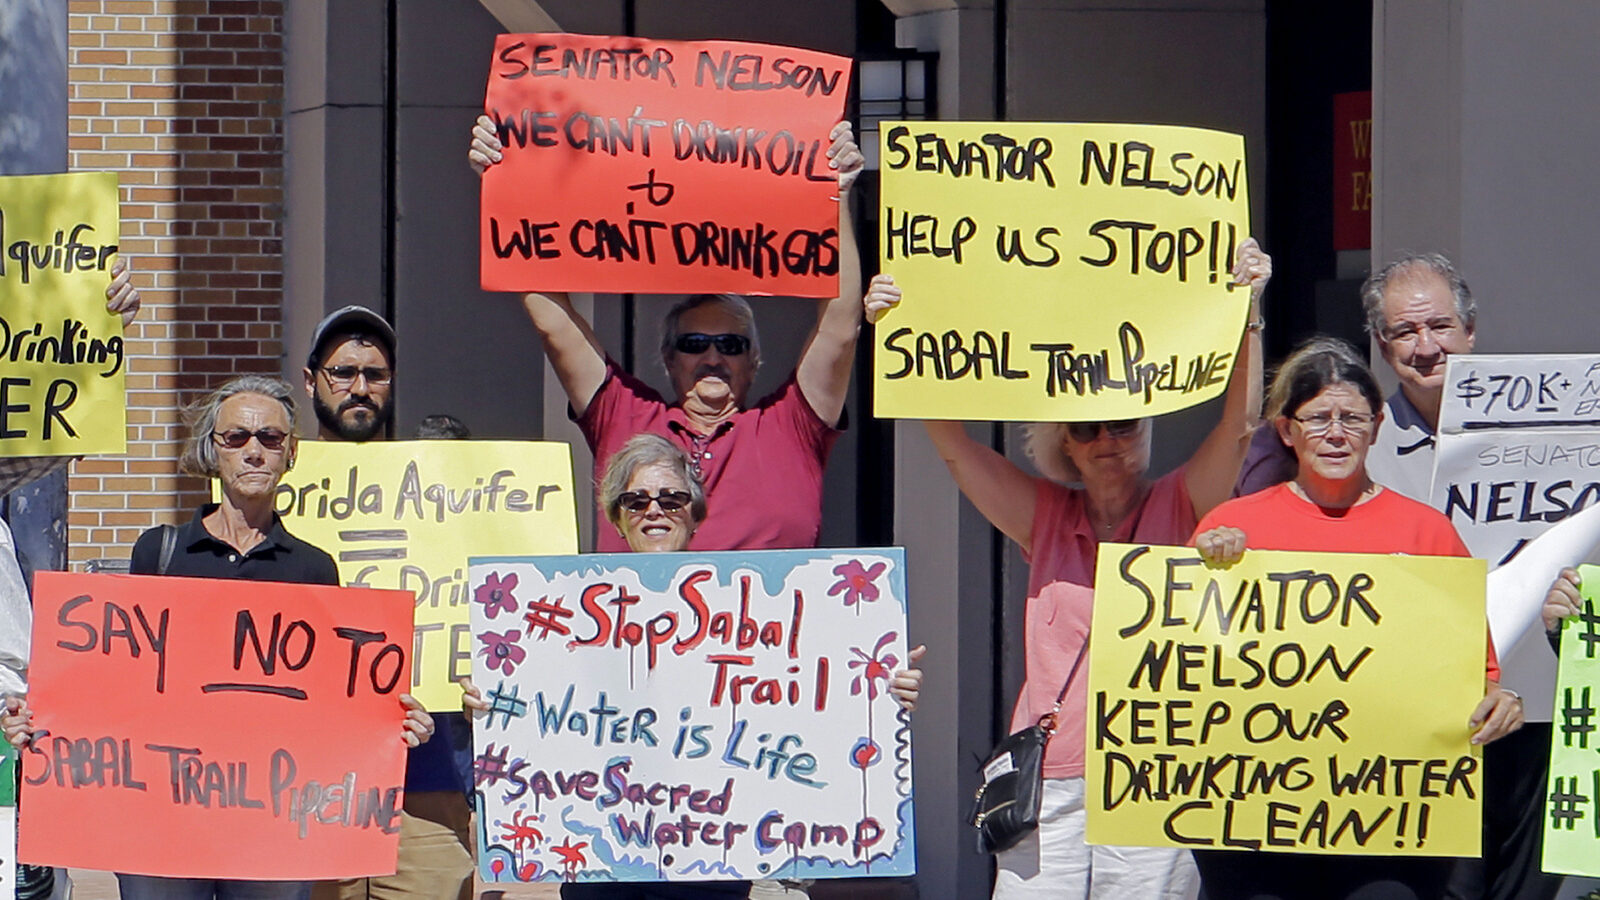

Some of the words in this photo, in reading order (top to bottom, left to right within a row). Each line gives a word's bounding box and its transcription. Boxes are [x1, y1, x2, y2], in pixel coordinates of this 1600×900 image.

[499, 42, 677, 88] SENATOR
[694, 51, 843, 97] NELSON
[493, 109, 558, 149] WE
[886, 126, 1056, 188] SENATOR
[1079, 140, 1241, 201] NELSON
[0, 206, 118, 283] quifer
[489, 217, 560, 260] WE
[886, 207, 976, 264] HELP
[884, 327, 1029, 380] SABAL
[1030, 343, 1126, 397] TRAIL
[394, 460, 562, 522] Aquifer
[1118, 546, 1383, 640] SENATOR
[57, 595, 170, 693] SAY
[233, 609, 316, 676] NO
[332, 626, 405, 698] TO
[1128, 640, 1374, 692] NELSON
[704, 654, 829, 712] Trail
[1096, 691, 1232, 750] KEEP
[1243, 699, 1350, 743] OUR
[25, 730, 147, 791] SABAL
[145, 743, 265, 808] TRAIL
[722, 719, 829, 788] Life
[1104, 752, 1315, 812] DRINKING
[1328, 755, 1479, 800] WATER
[609, 809, 748, 851] Water
[755, 810, 885, 858] Camp
[1163, 800, 1431, 851] CLEAN!!
